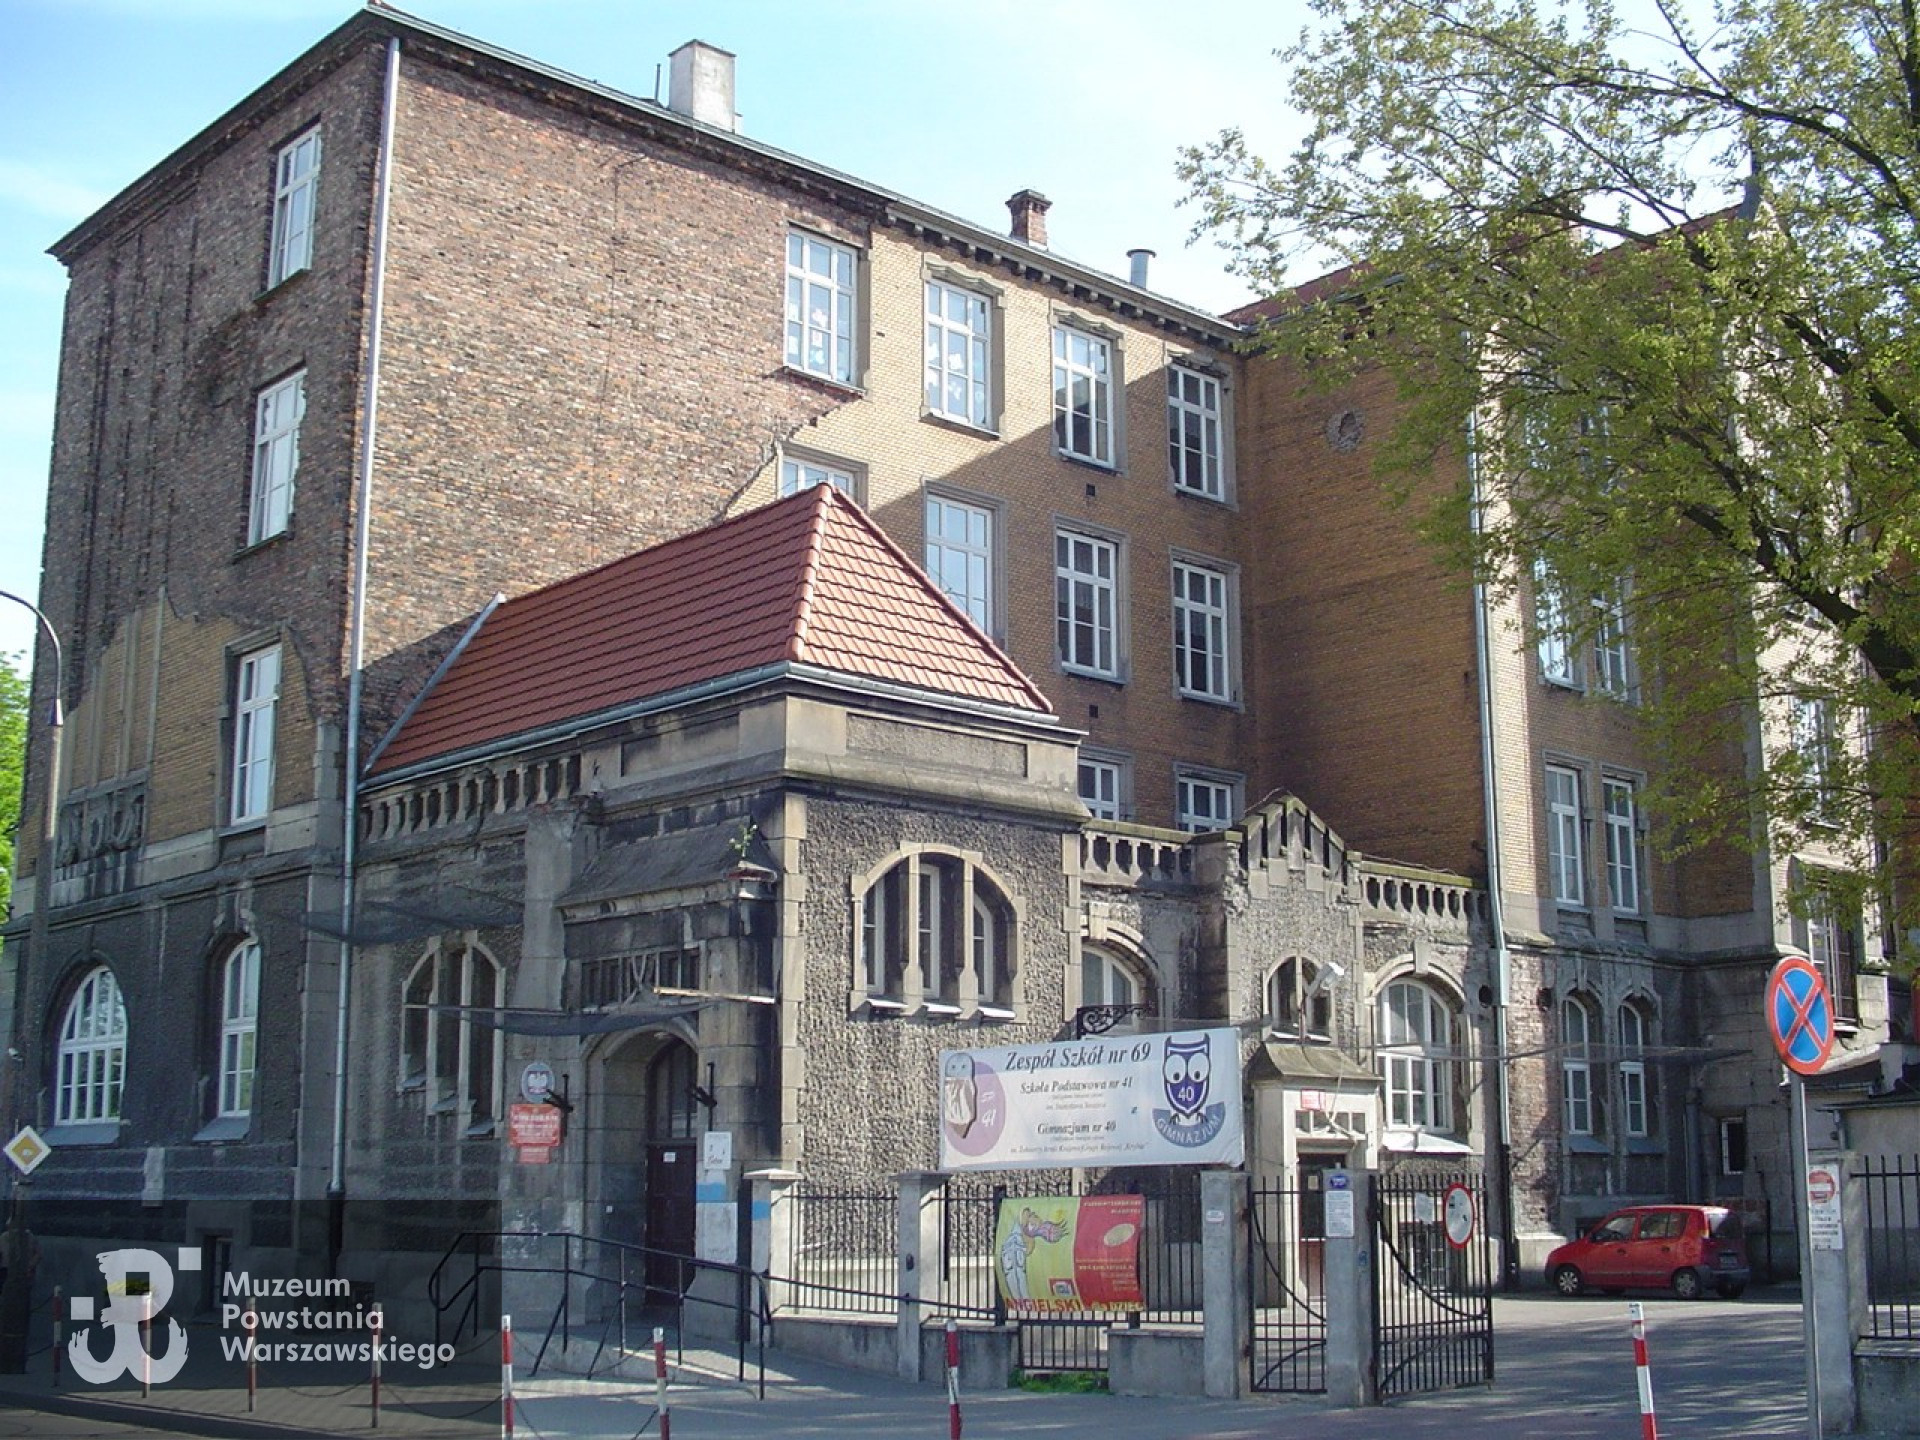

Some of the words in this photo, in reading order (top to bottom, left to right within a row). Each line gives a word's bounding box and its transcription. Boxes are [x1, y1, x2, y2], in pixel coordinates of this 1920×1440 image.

[1005, 1048, 1056, 1074] Zespół
[1060, 1045, 1104, 1067] Szkół
[1108, 1049, 1127, 1064] nr
[1131, 1042, 1152, 1062] 69
[1108, 1080, 1120, 1089] nr
[1121, 1077, 1133, 1088] 41
[1178, 1086, 1195, 1102] 40
[1157, 1114, 1220, 1144] GIMNAZJUM
